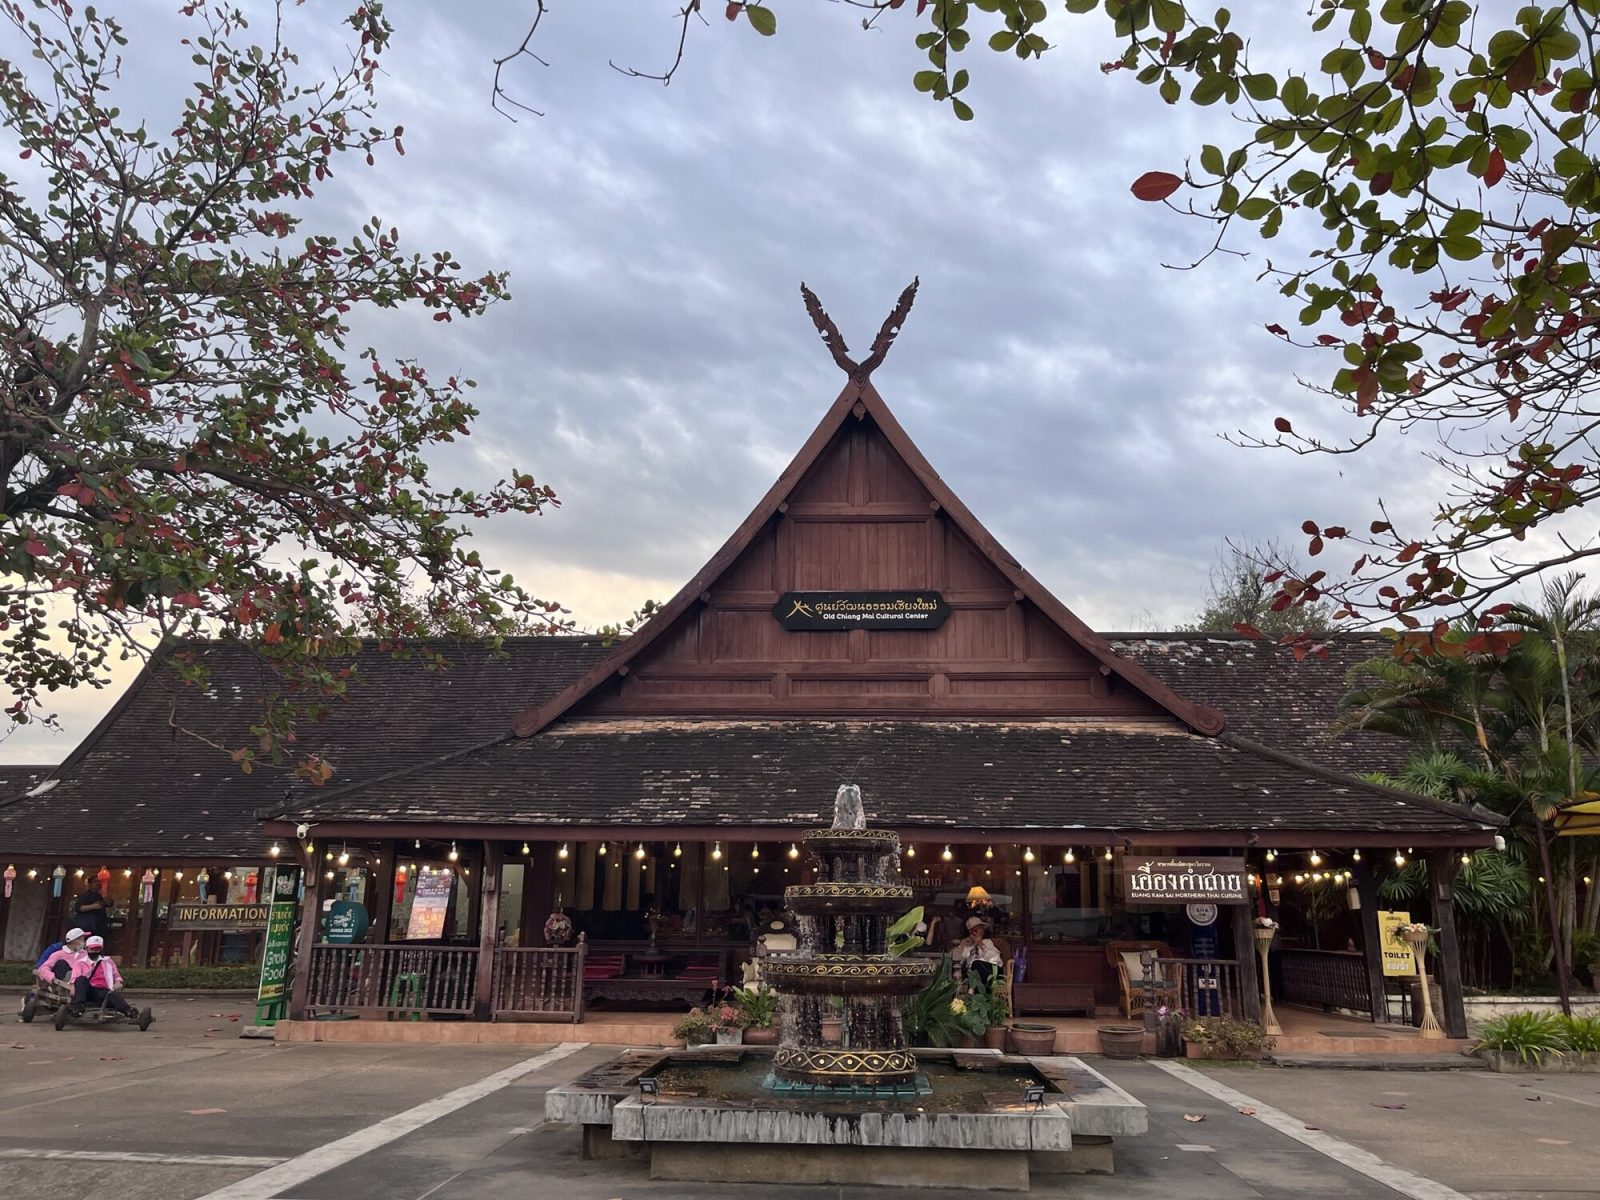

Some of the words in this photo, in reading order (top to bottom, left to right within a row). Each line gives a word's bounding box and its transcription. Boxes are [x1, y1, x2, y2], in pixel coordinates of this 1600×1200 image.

[815, 598, 937, 614] ศูนย์วัฒนธรรมเชียงใหม่
[836, 613, 861, 621] Chiang
[1131, 861, 1241, 891] เอื้องคำสาย
[179, 907, 268, 920] INFORMATION
[266, 949, 287, 966] Grab
[263, 964, 286, 980] Food
